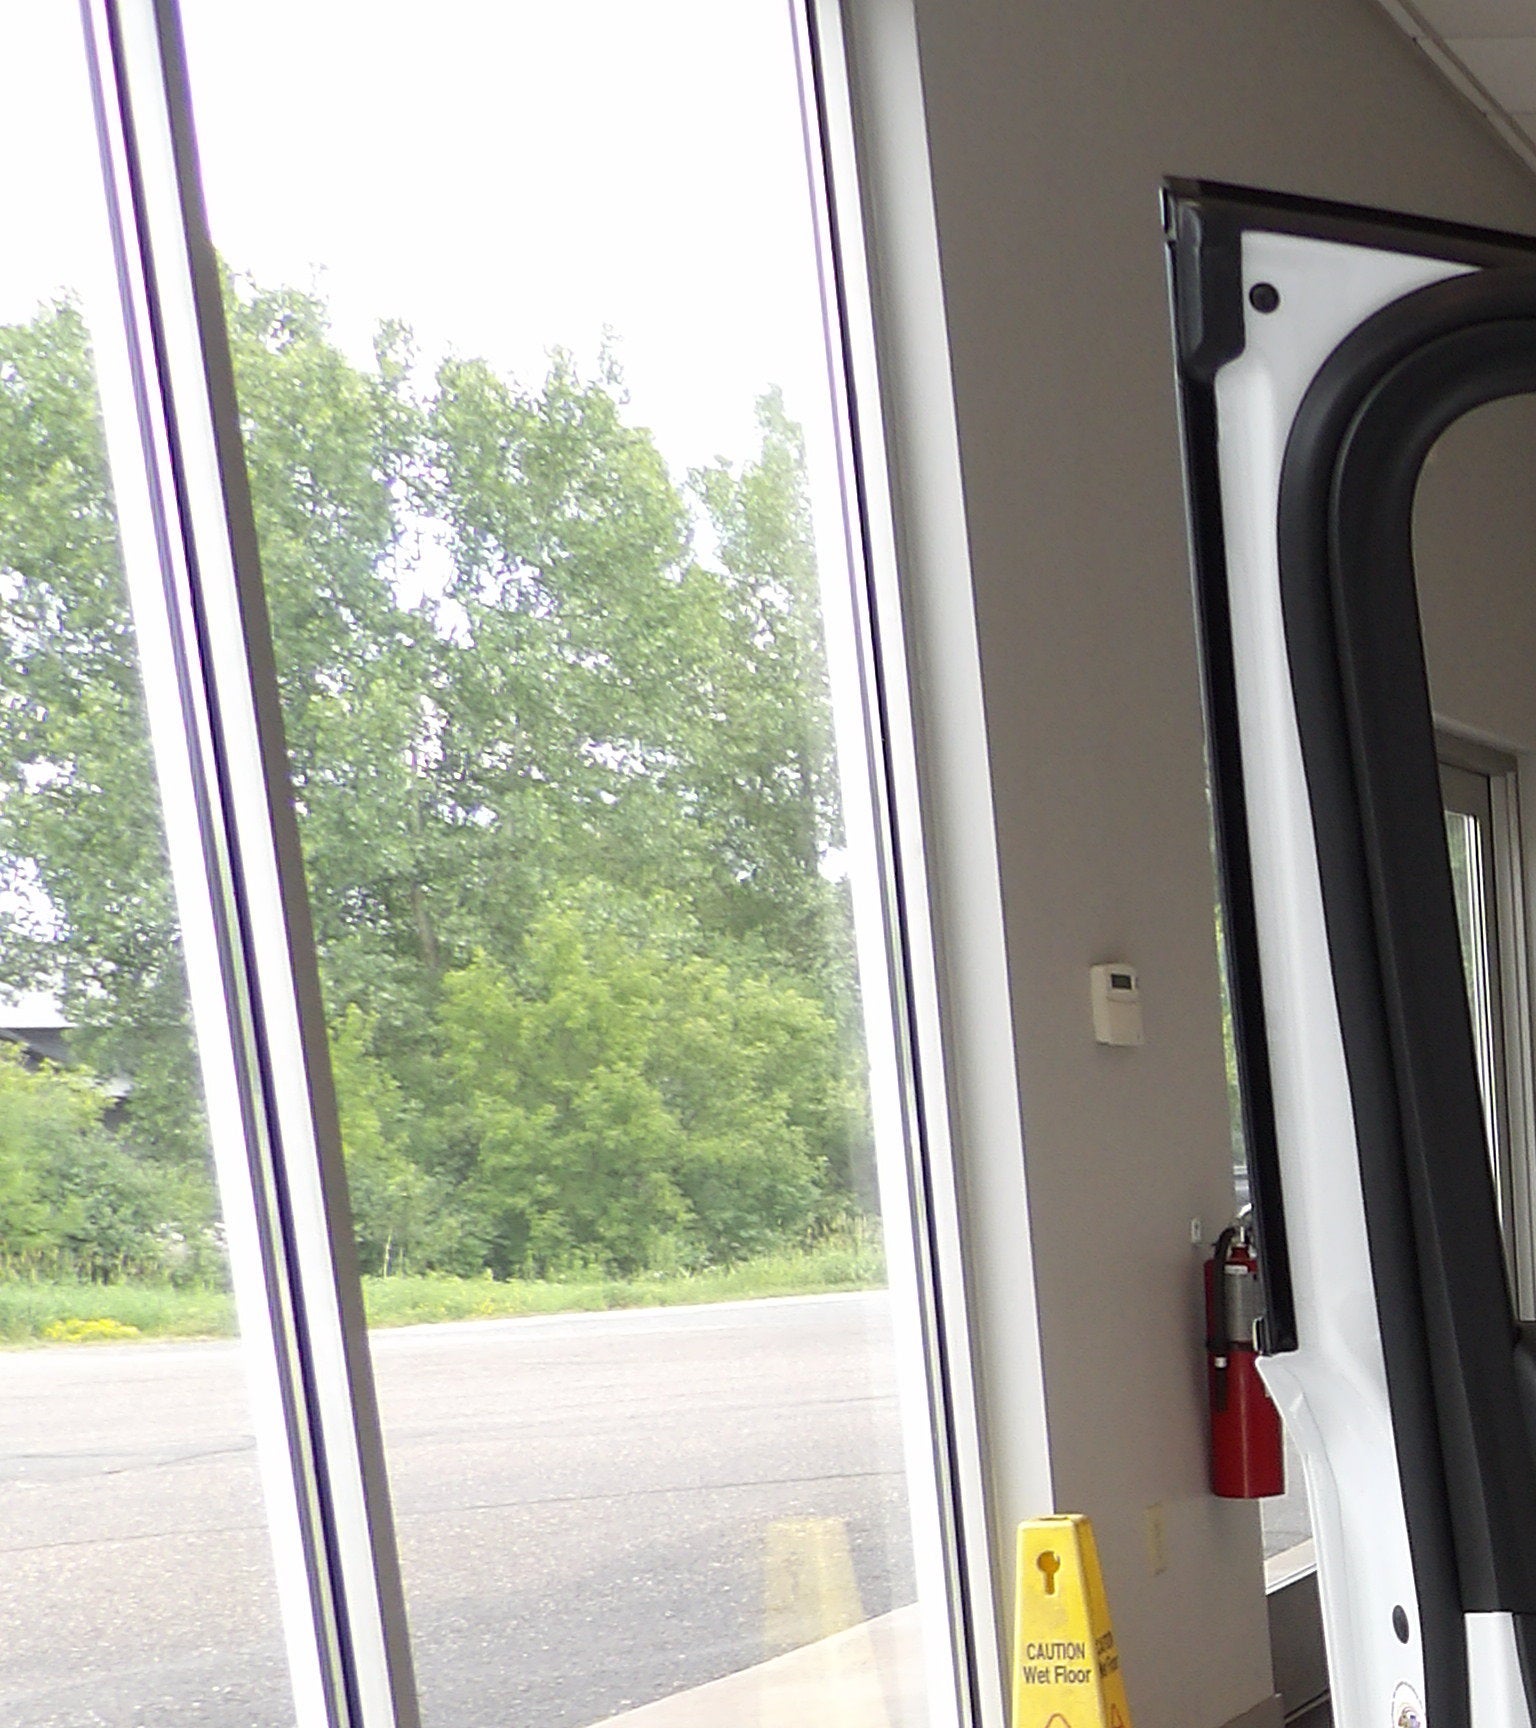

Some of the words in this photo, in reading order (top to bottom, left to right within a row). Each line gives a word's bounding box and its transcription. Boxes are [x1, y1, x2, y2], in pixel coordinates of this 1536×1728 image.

[1026, 1642, 1086, 1660] CAUTION
[1023, 1665, 1051, 1684] Wet
[1054, 1664, 1092, 1683] Floor
